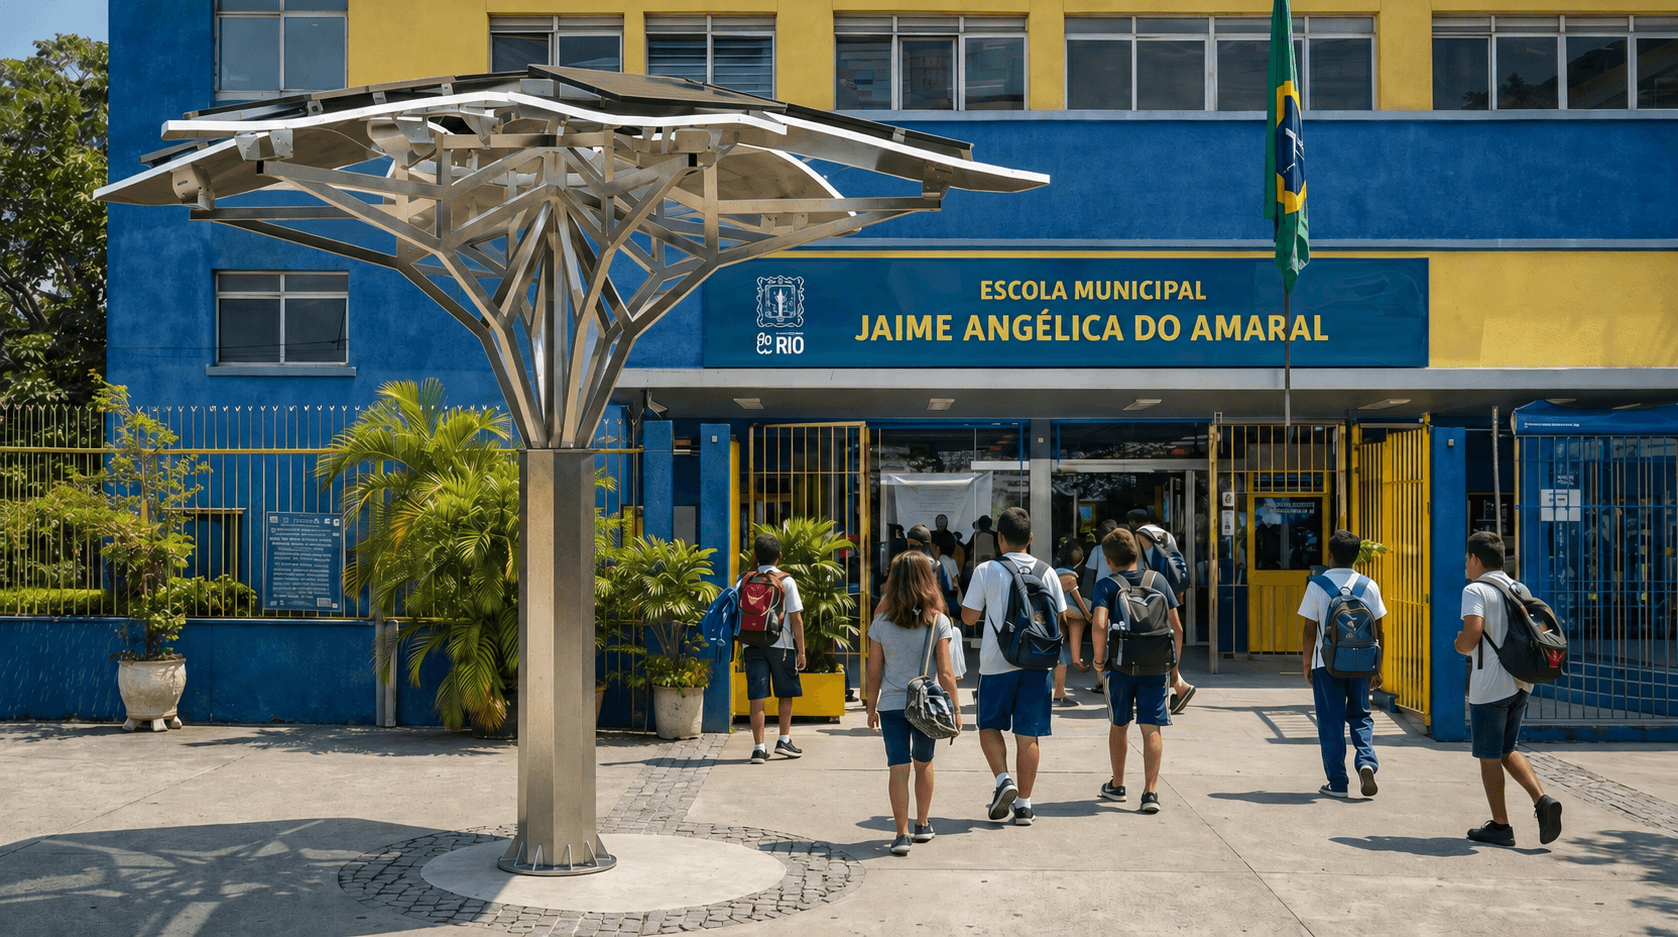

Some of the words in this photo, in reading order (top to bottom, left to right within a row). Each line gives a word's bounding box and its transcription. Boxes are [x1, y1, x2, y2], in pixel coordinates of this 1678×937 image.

[980, 280, 1068, 300] ESCOLA
[1074, 280, 1207, 300] MUNICIPAL
[854, 314, 953, 341] JAIME
[963, 307, 1124, 341] ANGÉLICA
[1134, 314, 1181, 341] DO
[1190, 314, 1329, 341] AMARAL
[776, 336, 805, 355] RIO
